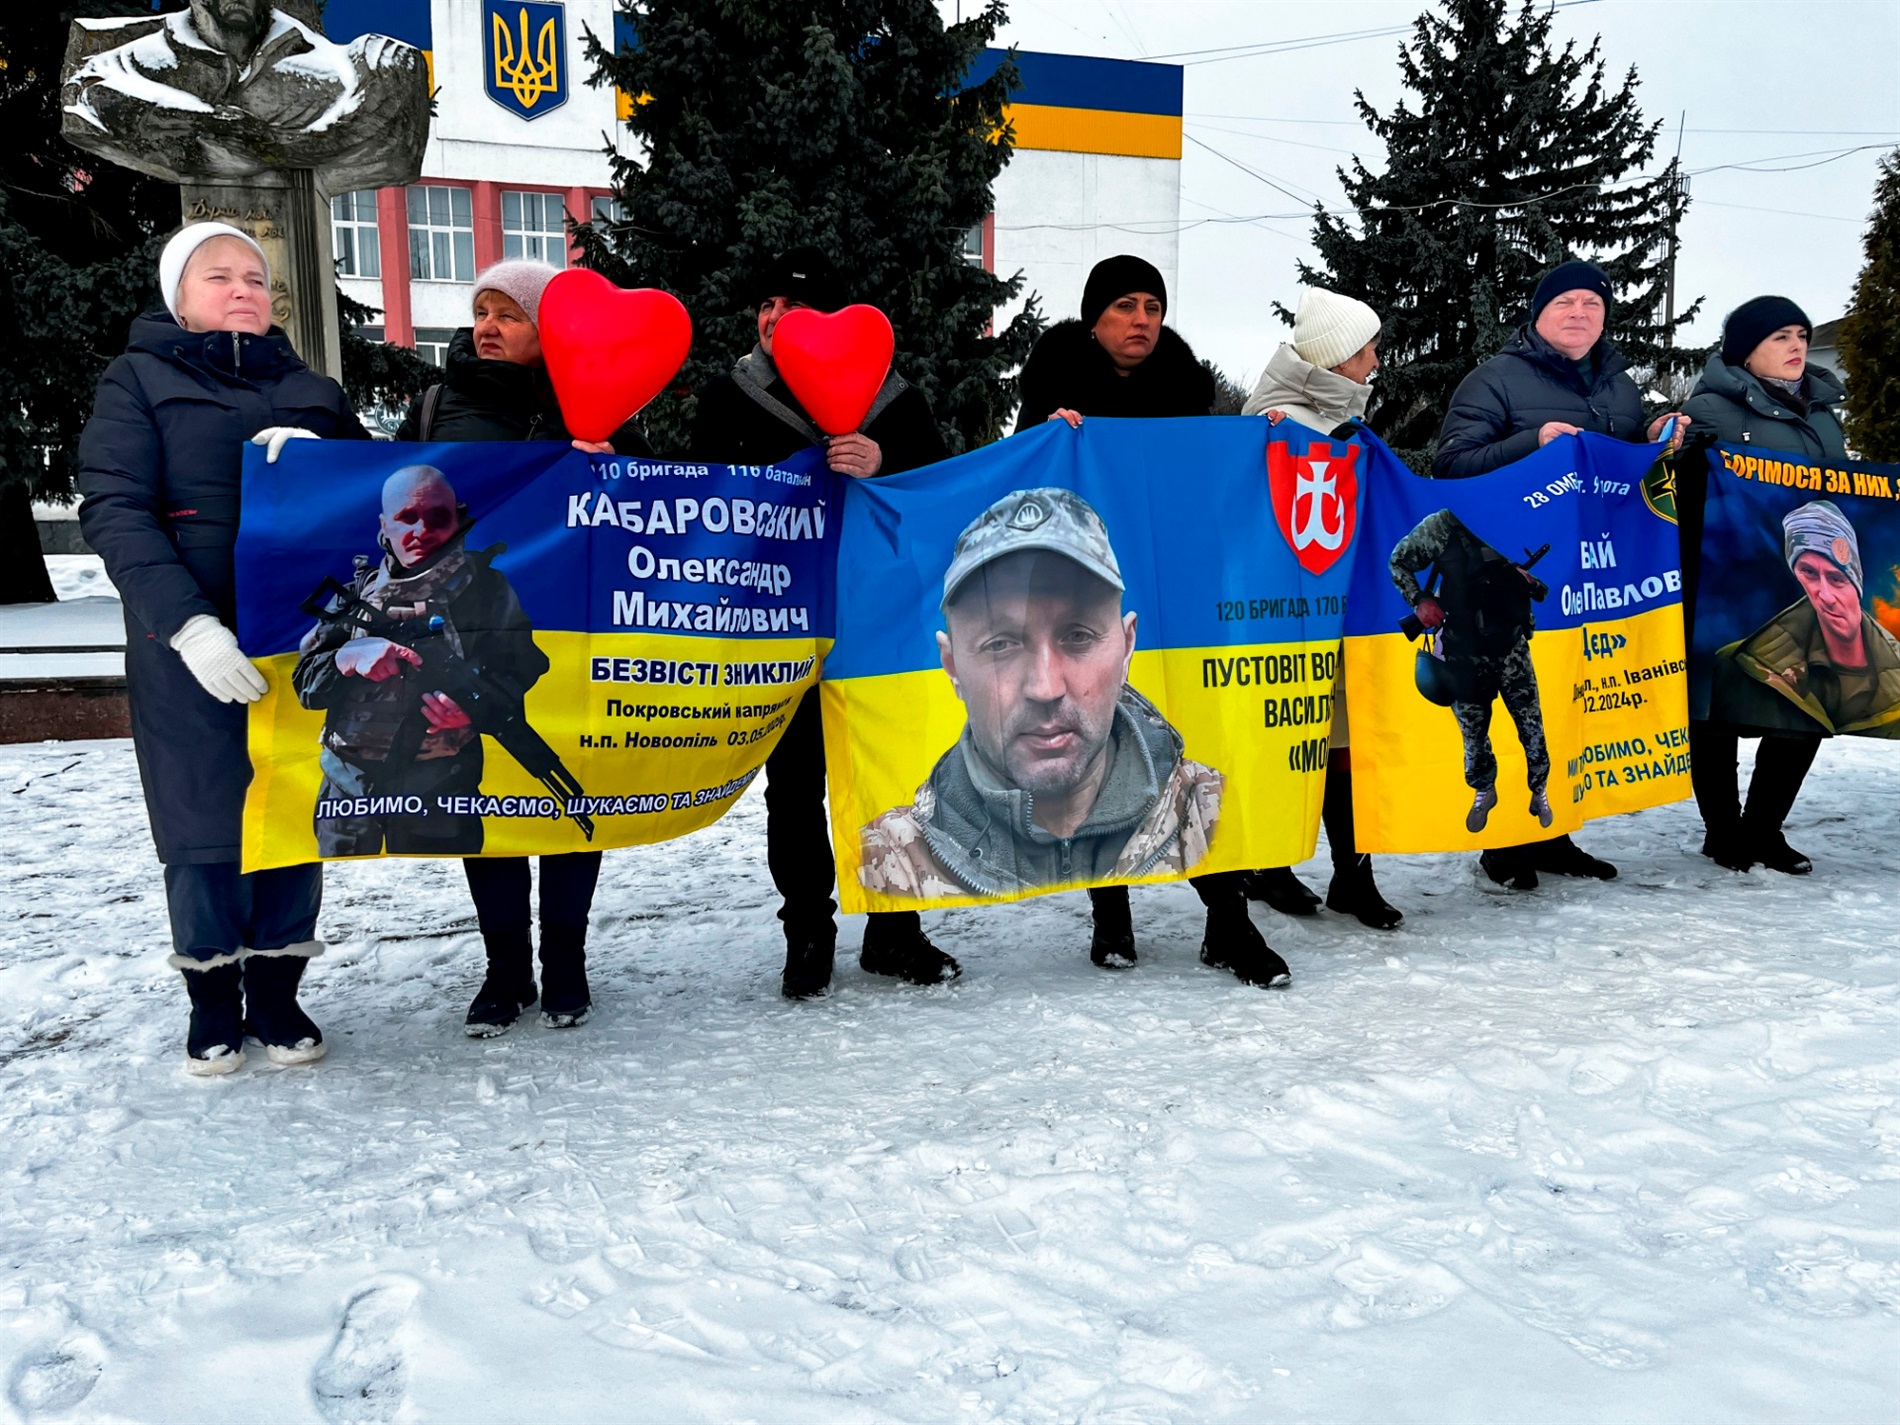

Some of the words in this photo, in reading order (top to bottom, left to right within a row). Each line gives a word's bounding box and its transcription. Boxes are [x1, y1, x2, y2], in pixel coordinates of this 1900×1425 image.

[626, 461, 709, 481] бригада
[727, 464, 761, 478] 116
[1825, 468, 1852, 494] ЗА
[1852, 472, 1893, 498] НИХ
[1523, 491, 1550, 509] 28
[567, 491, 827, 541] КАБАРОВСЬКИЙ
[627, 545, 792, 596] Олександр
[612, 590, 809, 633] Михайлович
[1216, 600, 1245, 622] 120
[1249, 597, 1311, 620] БРИГАДА
[1315, 595, 1340, 617] 170
[591, 657, 719, 687] БЕЗВІСТІ
[722, 654, 815, 687] ЗНИКЛИЙ
[1202, 652, 1306, 688] ПУСТОВІТ
[1601, 675, 1621, 690] н.п.
[606, 699, 731, 721] Покровський
[1264, 692, 1332, 728] ВАСИЛ
[579, 734, 618, 748] н.п.
[624, 731, 718, 749] Новоопіль
[1595, 769, 1620, 788] ТА
[316, 795, 429, 819] ЛЮБИМО,
[437, 795, 561, 820] ЧЕКАЄМО,
[566, 795, 668, 815] ШУКАЄМО
[671, 792, 691, 809] ТА
